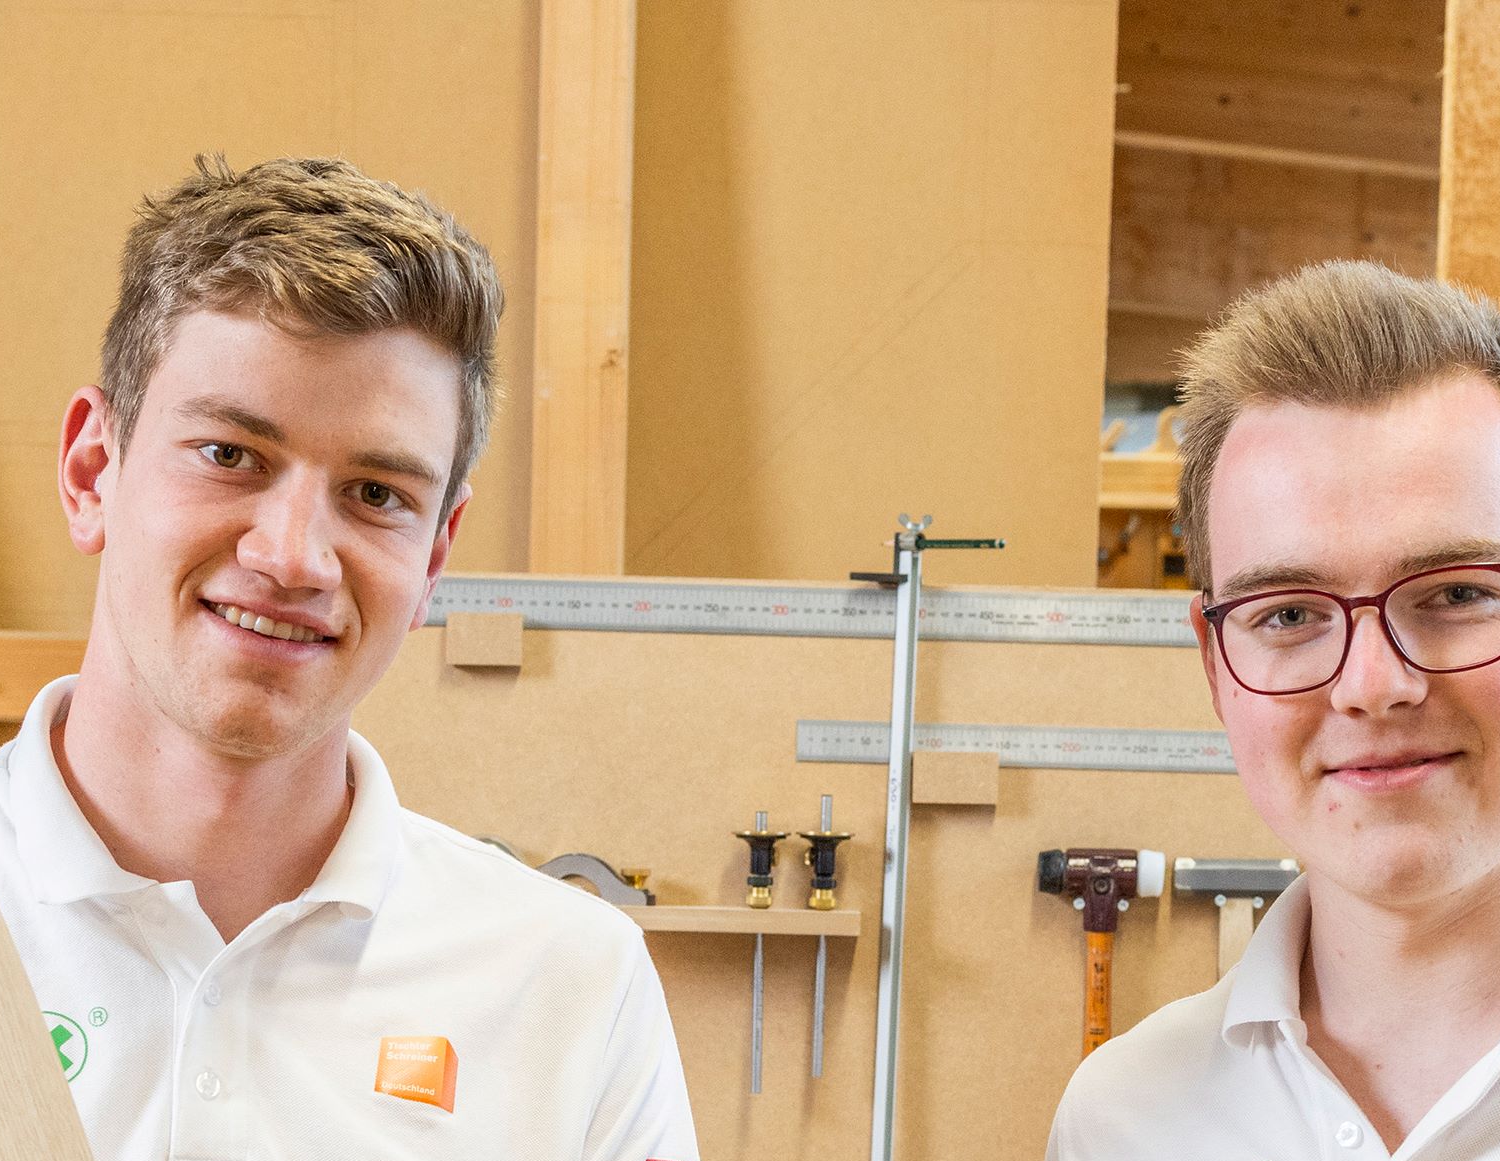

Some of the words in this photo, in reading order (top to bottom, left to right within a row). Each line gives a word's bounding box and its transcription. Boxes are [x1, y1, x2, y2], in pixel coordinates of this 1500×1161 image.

[388, 1041, 431, 1050] Tischler
[386, 1051, 438, 1063] Schreiner
[381, 1080, 435, 1096] Deutschland
